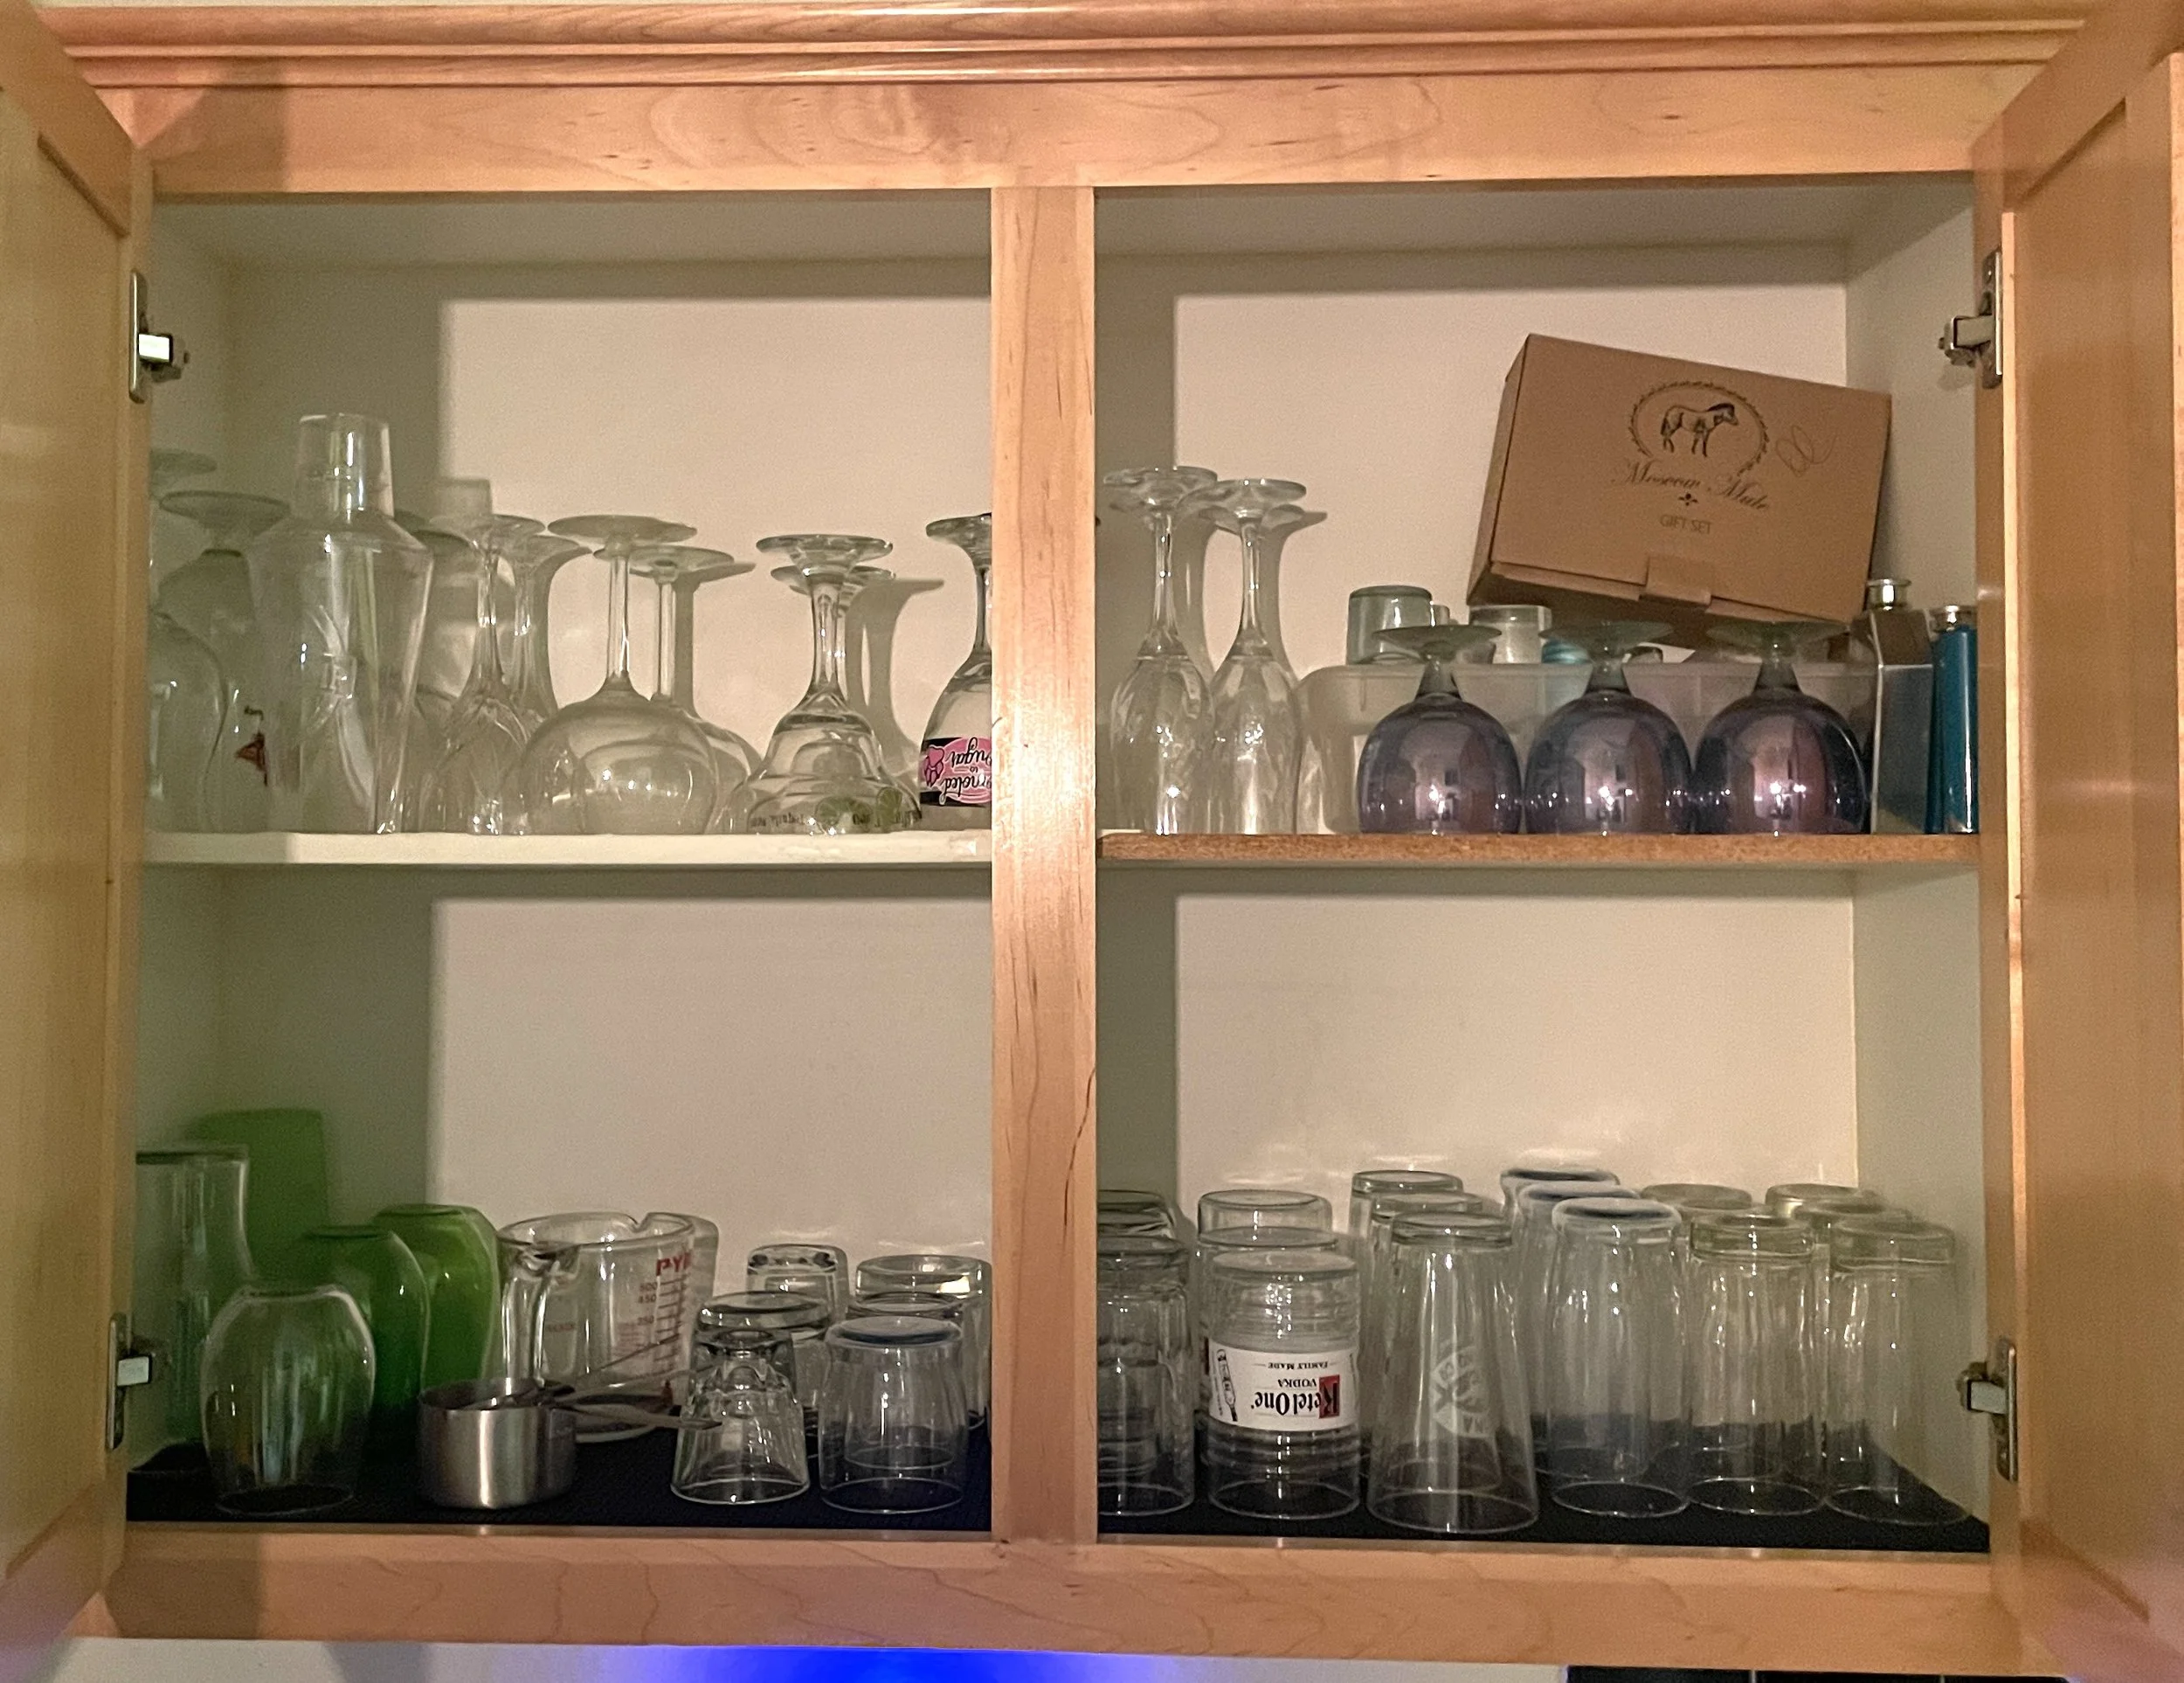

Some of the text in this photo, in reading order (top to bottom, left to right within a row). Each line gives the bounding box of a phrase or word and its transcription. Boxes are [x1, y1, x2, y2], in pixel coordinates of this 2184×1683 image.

[1707, 471, 1771, 510] Mule
[1659, 514, 1713, 535] GIFT SET
[1267, 1361, 1328, 1371] FAMILY MADE
[1277, 1378, 1317, 1389] VODKA
[1253, 1381, 1340, 1416] Ketel One
